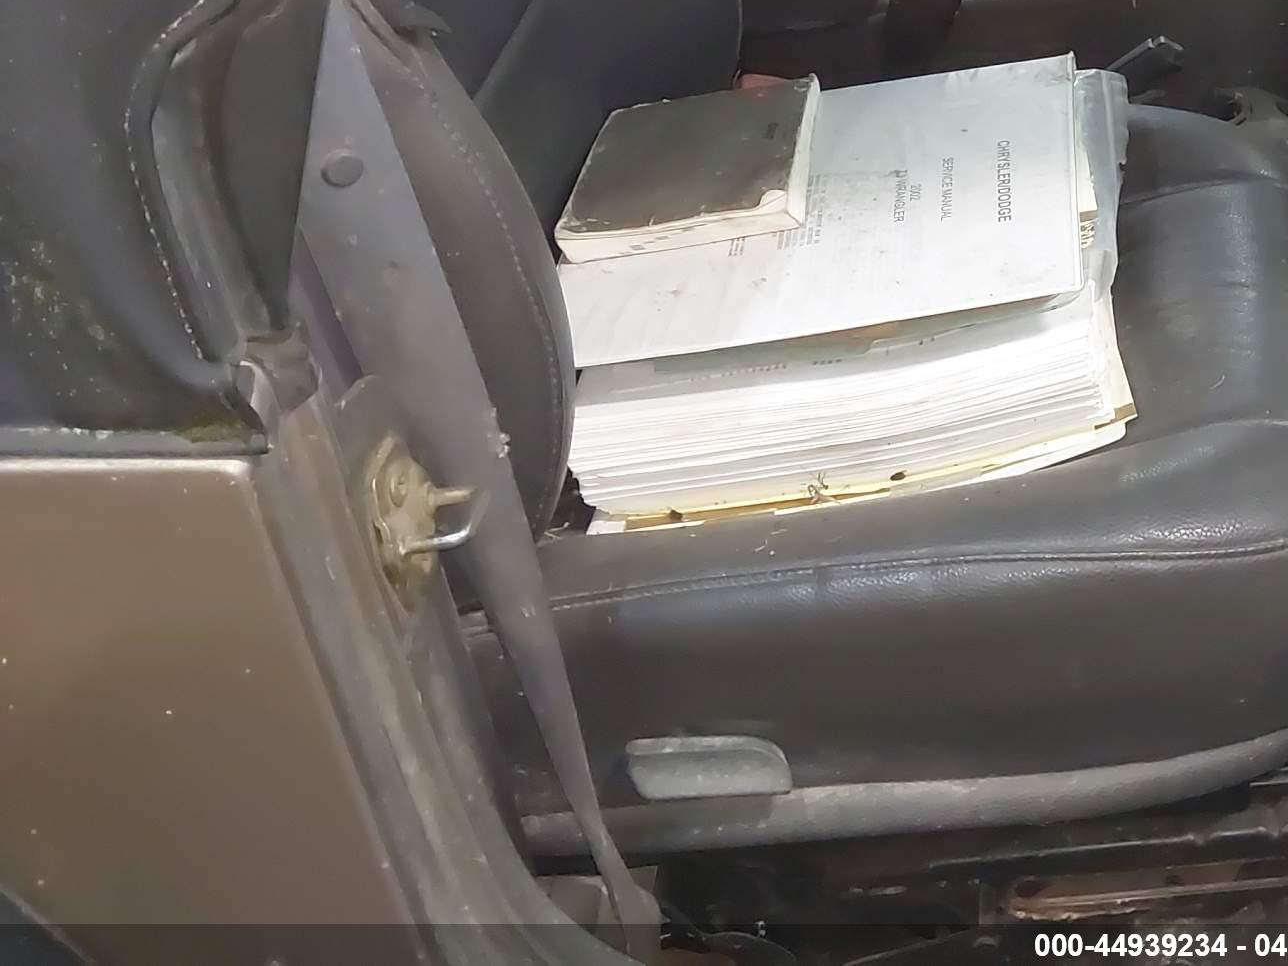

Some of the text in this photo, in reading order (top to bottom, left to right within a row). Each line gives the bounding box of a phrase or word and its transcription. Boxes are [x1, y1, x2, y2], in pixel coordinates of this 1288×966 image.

[894, 178, 907, 223] WRANGLER
[940, 157, 954, 222] SERVICE MANUAL
[996, 140, 1012, 223] CHRYSLER/DODGE
